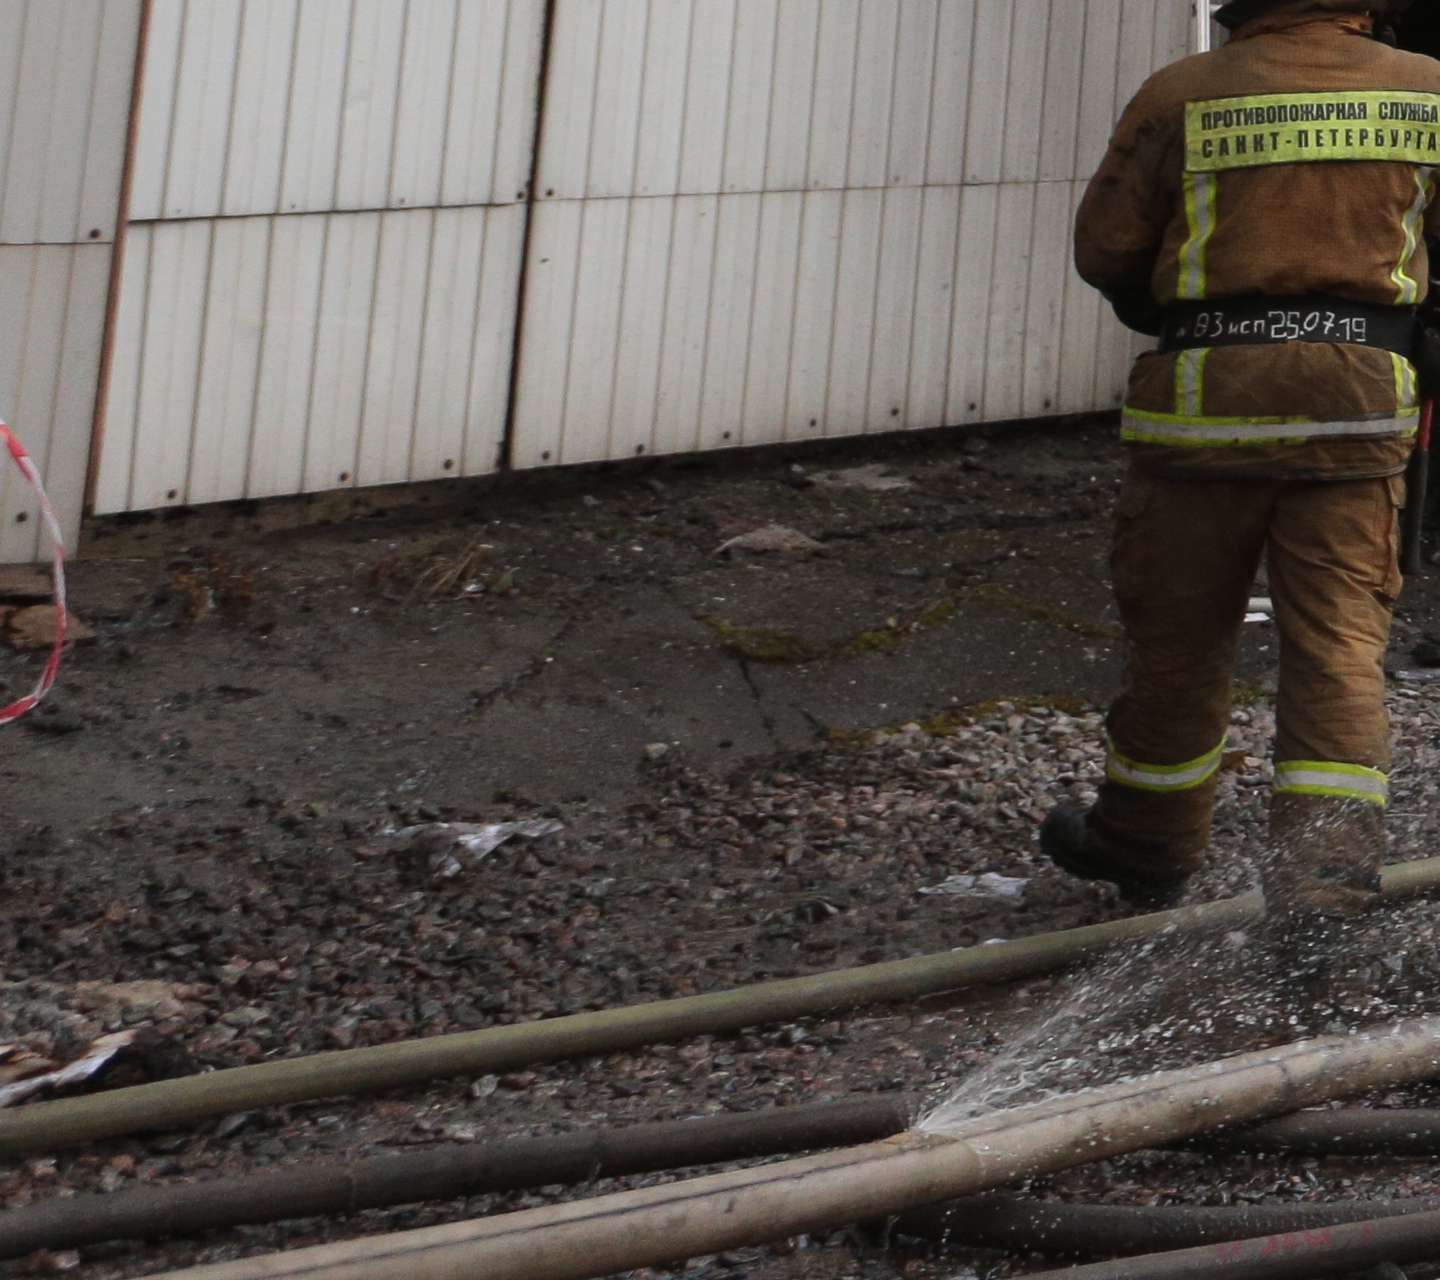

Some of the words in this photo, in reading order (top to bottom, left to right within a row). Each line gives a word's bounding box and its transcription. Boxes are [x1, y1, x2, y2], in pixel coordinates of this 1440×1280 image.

[1201, 101, 1367, 131] ПРОТИВОПОЖАРНАЯ
[1378, 101, 1438, 124] СЛУЖБА
[1201, 128, 1438, 159] САНКТ-ПЕТЕРБУРГА
[1268, 311, 1367, 341] 25.07.19
